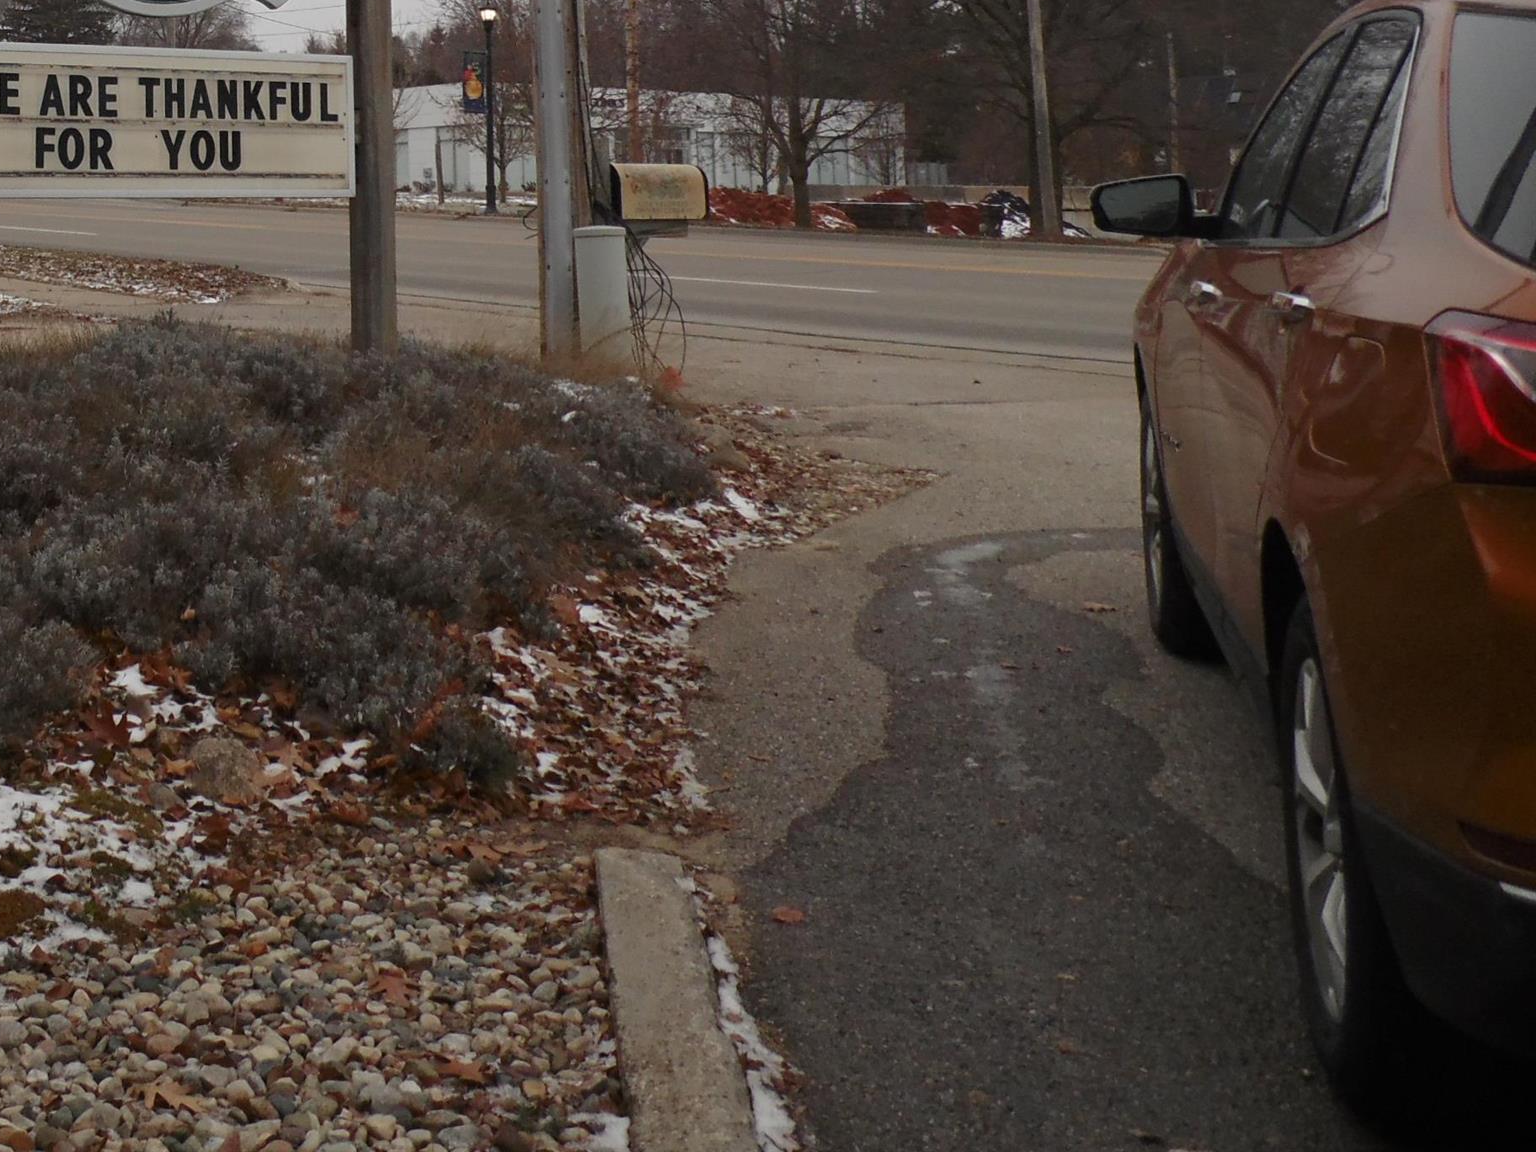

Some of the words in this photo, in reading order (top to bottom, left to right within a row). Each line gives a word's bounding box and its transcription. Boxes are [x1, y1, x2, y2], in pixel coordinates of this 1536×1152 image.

[39, 74, 119, 118] ARE
[138, 77, 339, 122] THANKFUL
[35, 127, 114, 170] FOR
[161, 129, 241, 171] YOU
